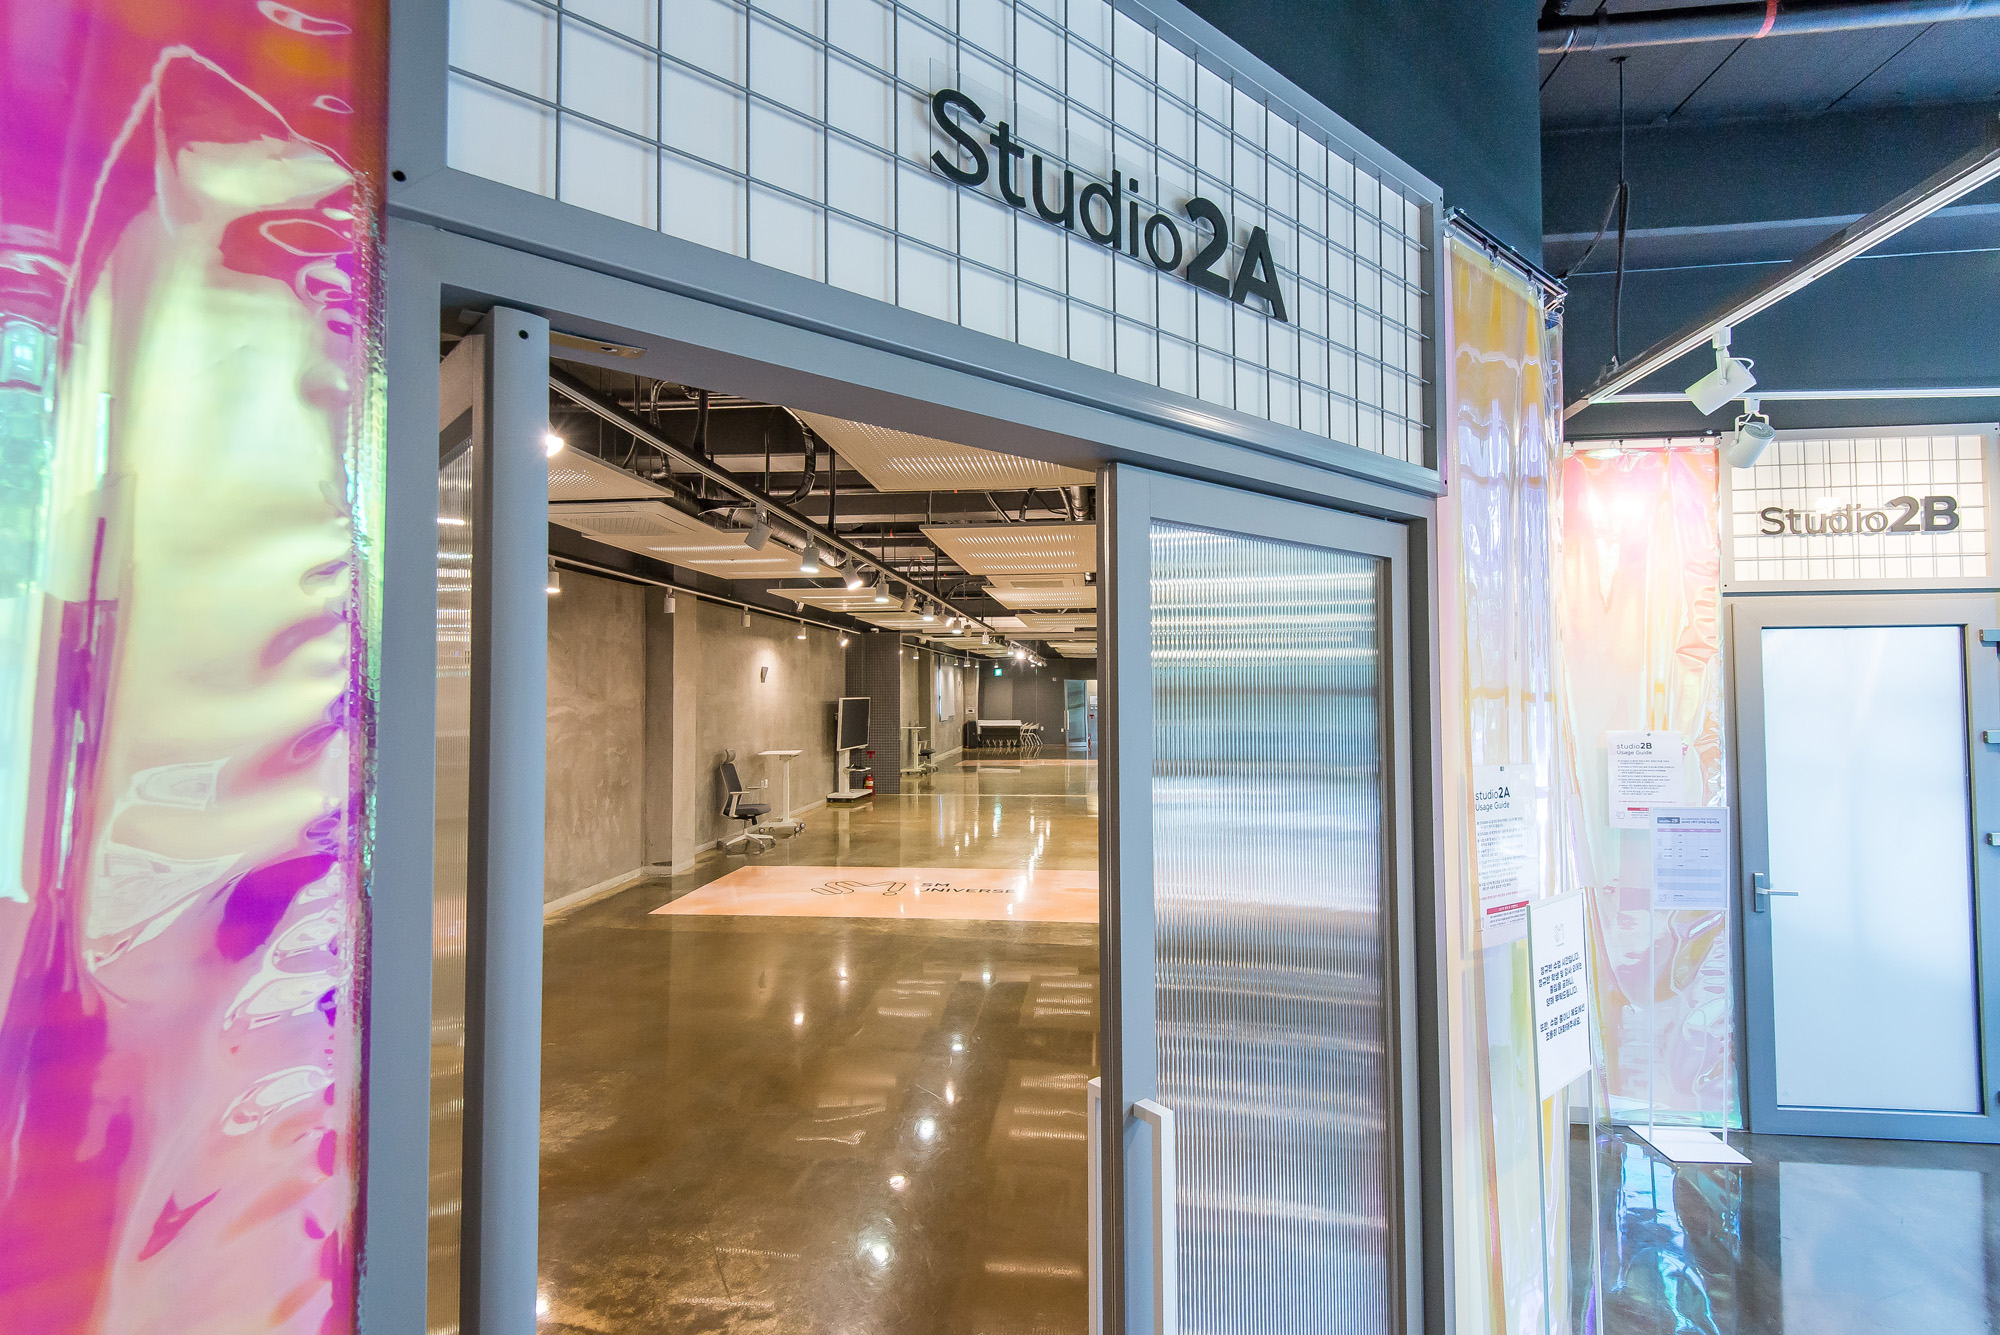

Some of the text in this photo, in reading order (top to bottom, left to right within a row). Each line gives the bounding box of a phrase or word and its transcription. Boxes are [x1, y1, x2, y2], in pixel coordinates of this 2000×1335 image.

[931, 88, 1288, 322] Studio2A
[1760, 495, 1960, 535] Studio2B
[1616, 742, 1653, 750] studio2B
[1475, 786, 1511, 801] studio2A
[1475, 801, 1510, 812] Usage Guide
[1540, 963, 1553, 976] 정규반
[1553, 960, 1561, 970] 수업
[1538, 975, 1551, 988] 정규반
[1550, 1016, 1559, 1027] 수업
